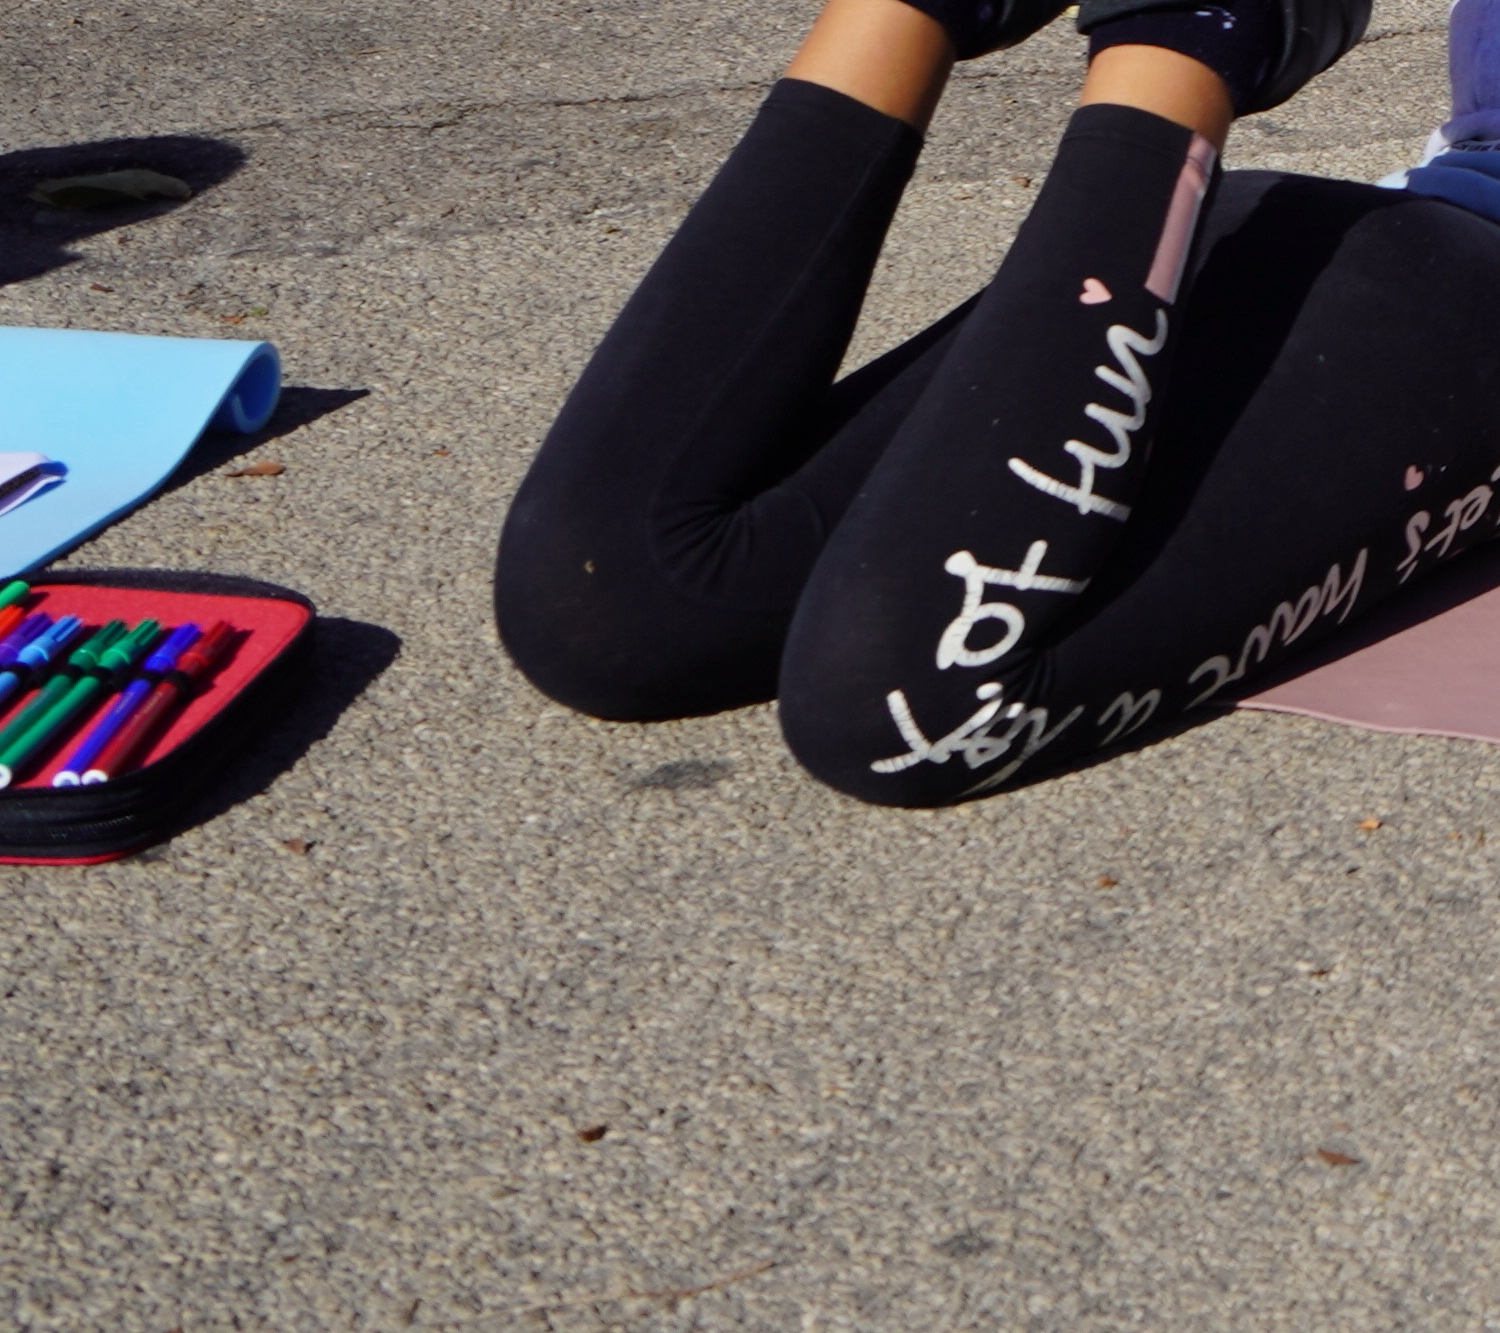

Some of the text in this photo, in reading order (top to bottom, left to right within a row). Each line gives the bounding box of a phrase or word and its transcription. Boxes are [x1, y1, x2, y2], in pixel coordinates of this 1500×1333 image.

[1007, 307, 1168, 525] fun
[1187, 547, 1369, 709] have
[1096, 687, 1164, 747] a
